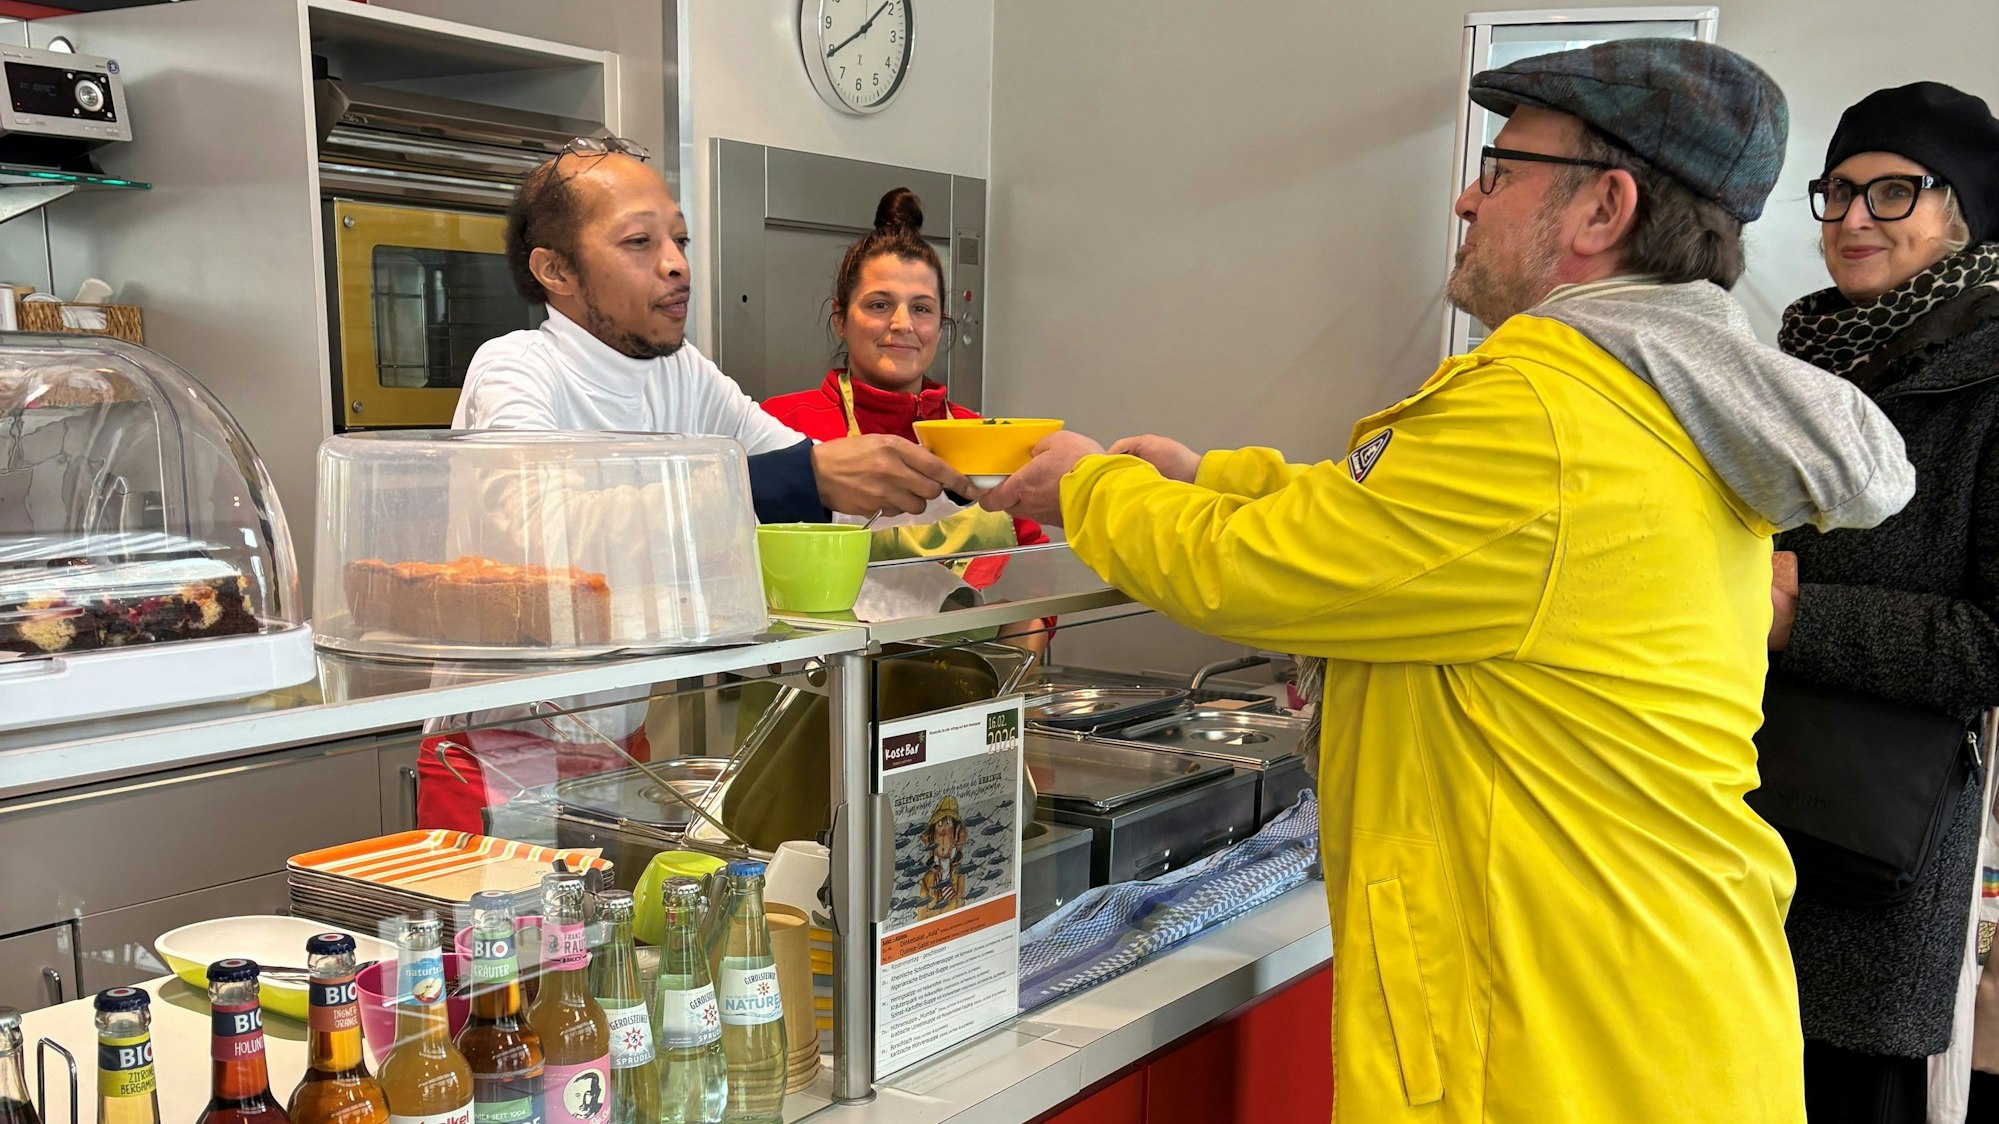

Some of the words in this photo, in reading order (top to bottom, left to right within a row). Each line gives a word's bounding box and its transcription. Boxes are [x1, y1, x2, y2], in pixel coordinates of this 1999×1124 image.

[888, 2, 894, 15] 2
[826, 15, 832, 29] 9
[890, 30, 896, 43] 3
[885, 56, 891, 68] 4
[840, 66, 846, 79] 7
[873, 73, 879, 86] 5
[856, 78, 862, 91] 6
[988, 715, 1007, 729] 16.02.
[988, 727, 1016, 755] 2026
[474, 940, 508, 957] BIO
[474, 964, 510, 979] KRÄUTER
[325, 982, 357, 1005] BIO
[616, 1052, 651, 1066] SPRUDEL
